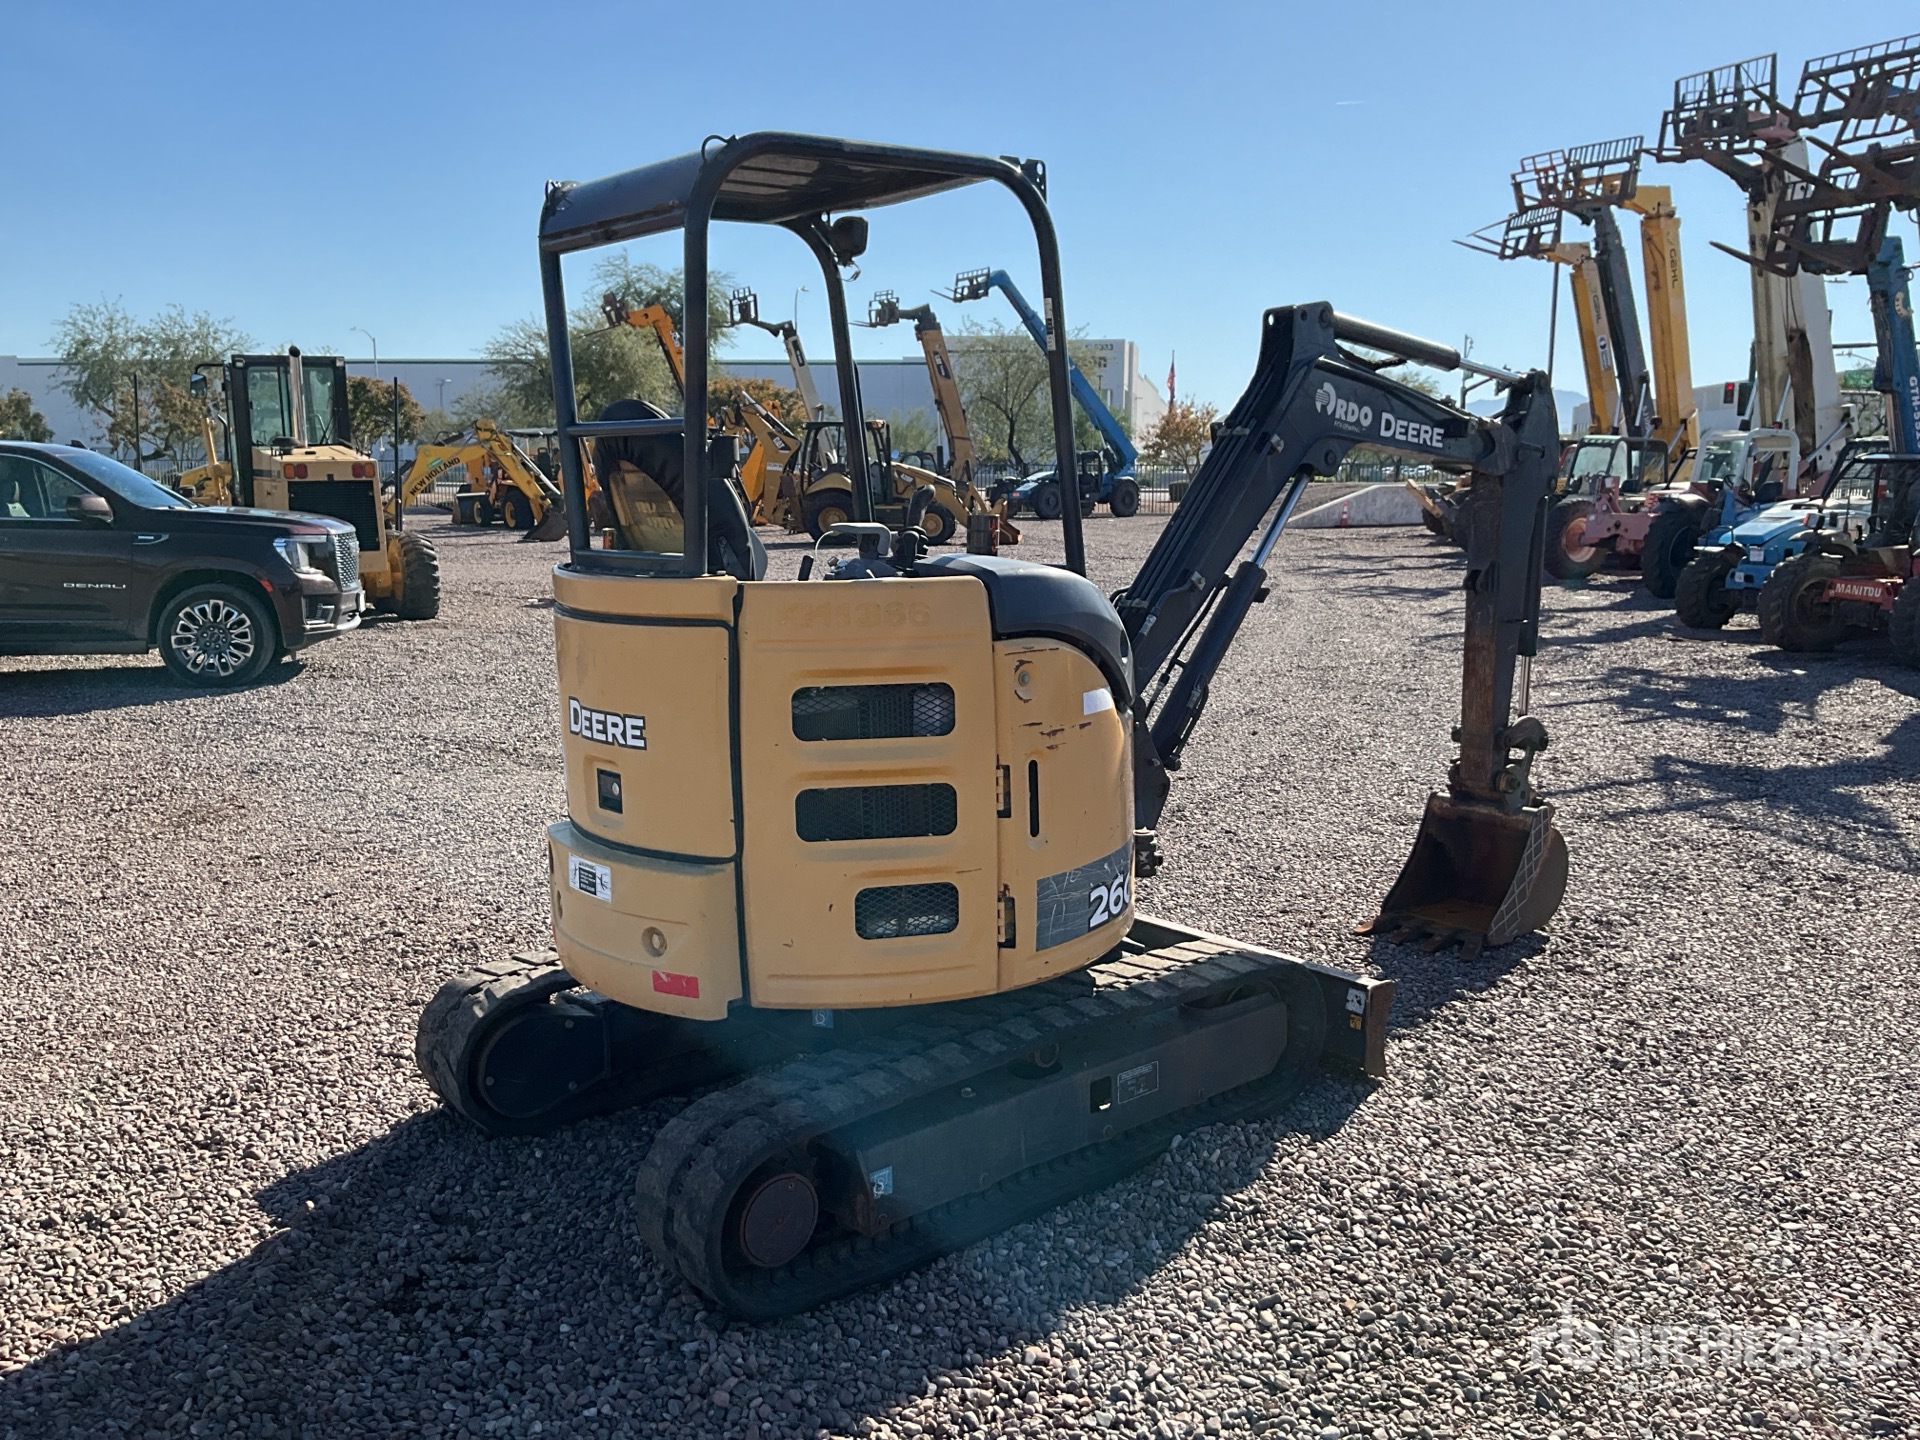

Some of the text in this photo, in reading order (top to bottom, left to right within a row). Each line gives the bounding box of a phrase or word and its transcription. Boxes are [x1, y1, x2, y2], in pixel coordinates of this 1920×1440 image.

[1669, 247, 1679, 289] GEHL
[1380, 411, 1445, 448] DEERE
[410, 457, 461, 496] NEW HOLLAND
[63, 582, 126, 590] DENALI
[1834, 583, 1882, 598] MANITOU
[568, 697, 646, 748] DEERE
